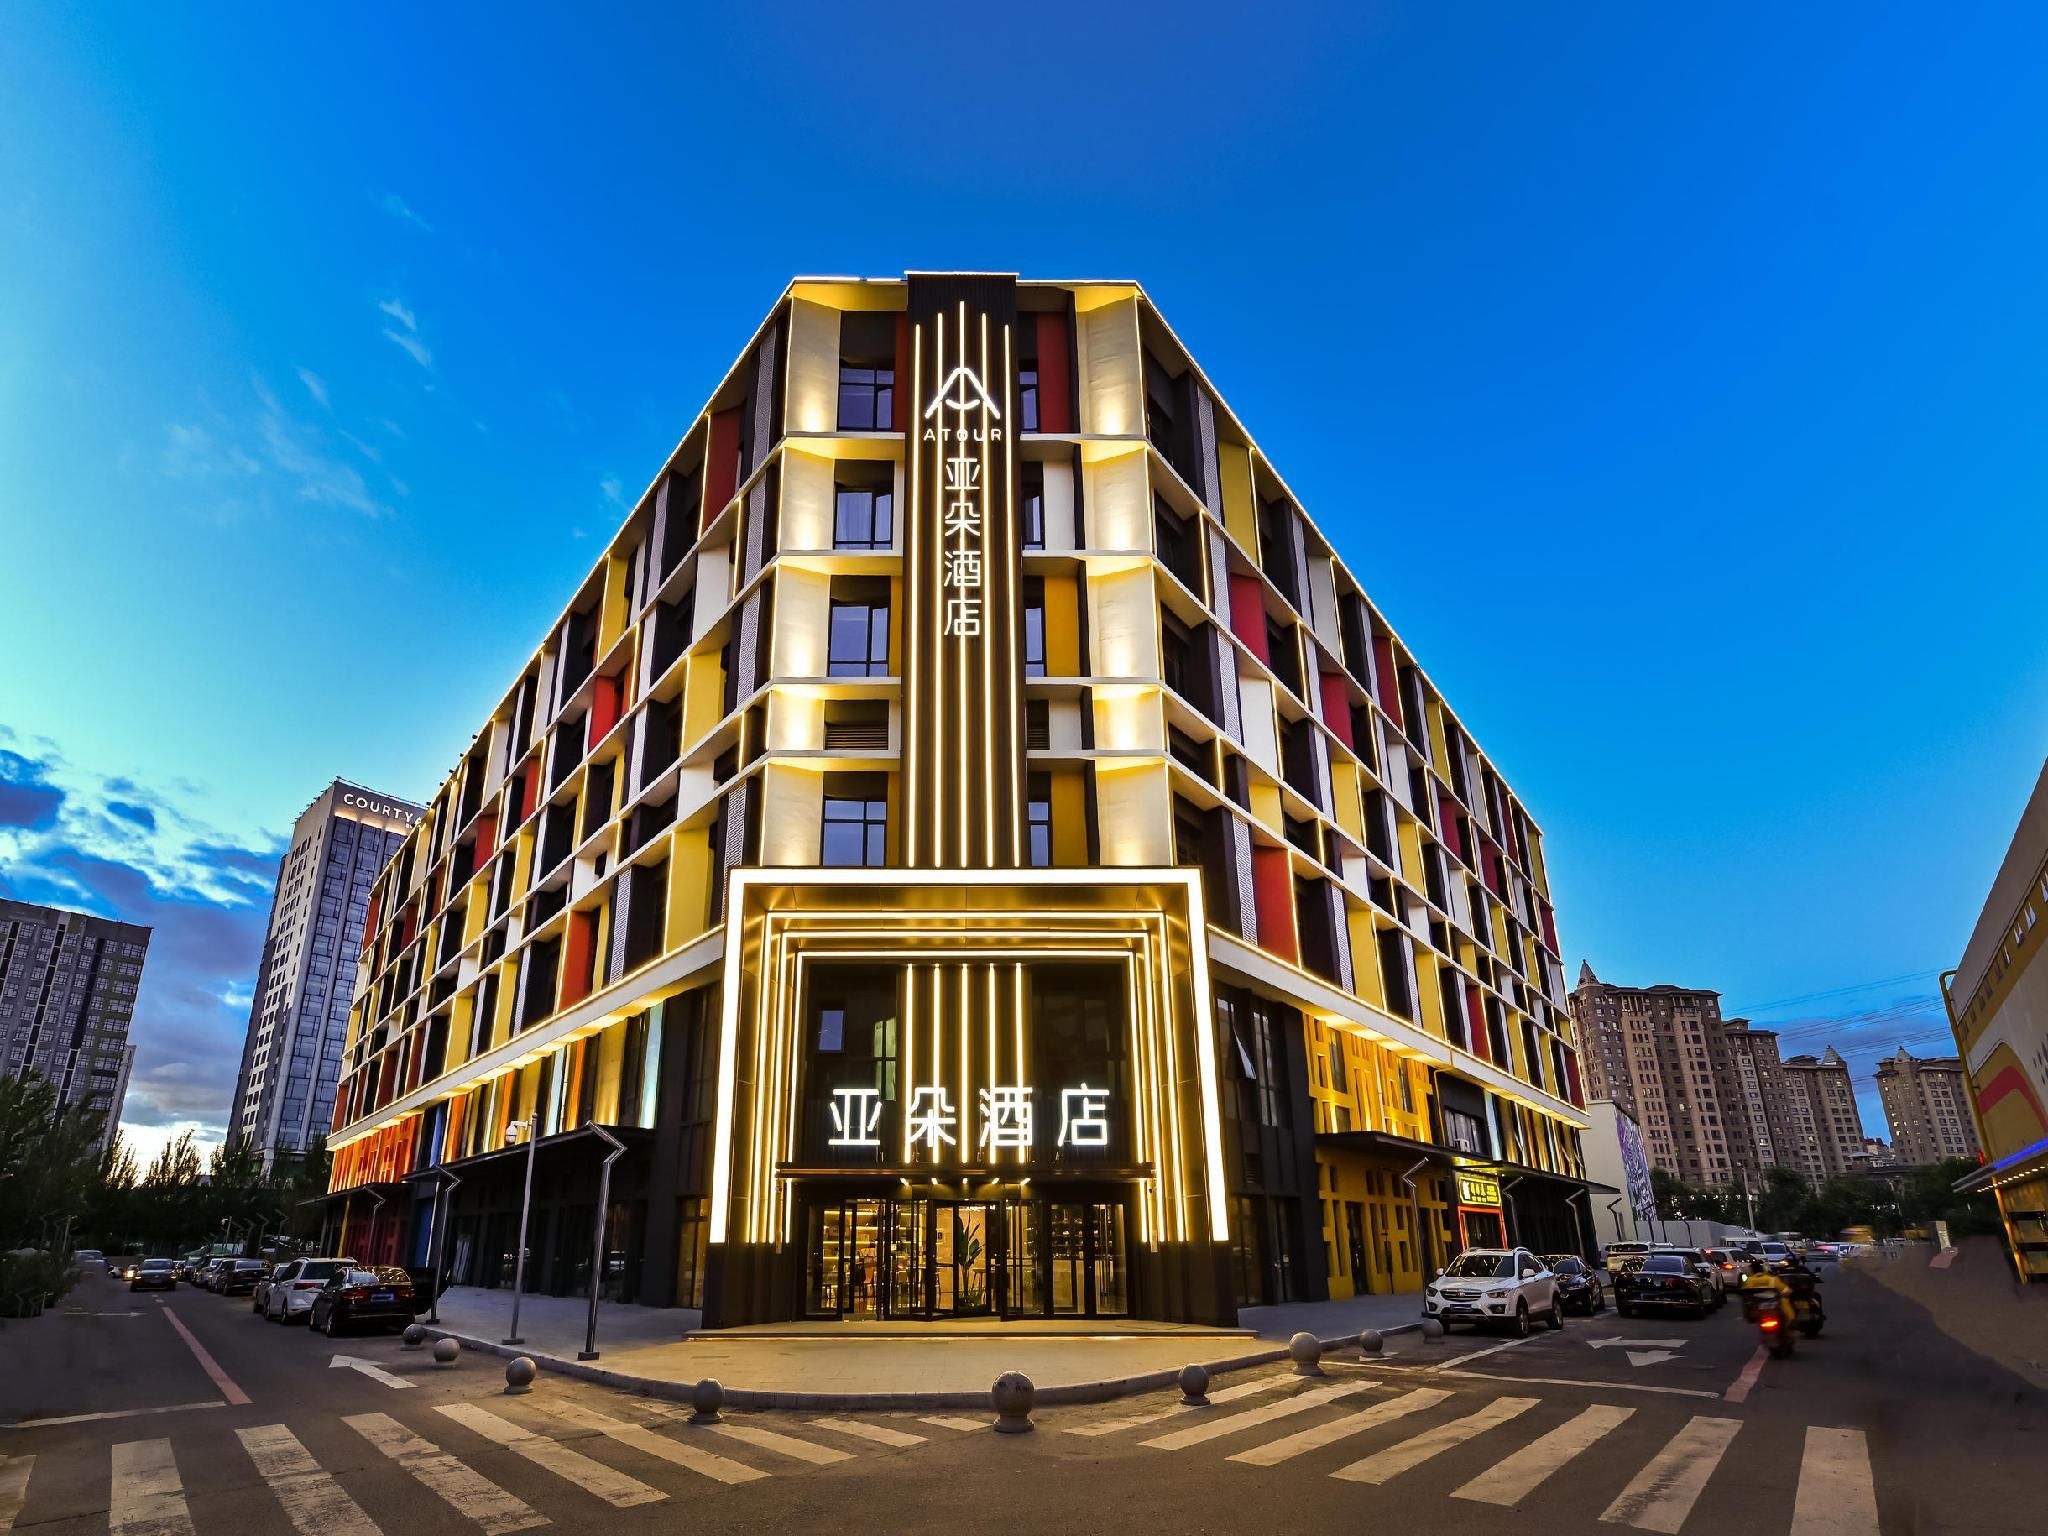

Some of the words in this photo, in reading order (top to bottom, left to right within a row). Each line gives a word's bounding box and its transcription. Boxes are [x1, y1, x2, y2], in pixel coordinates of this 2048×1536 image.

[923, 428, 1002, 442] ATOUR
[944, 457, 982, 636] 亚朵酒店
[828, 1083, 1110, 1148] 亚朵酒店
